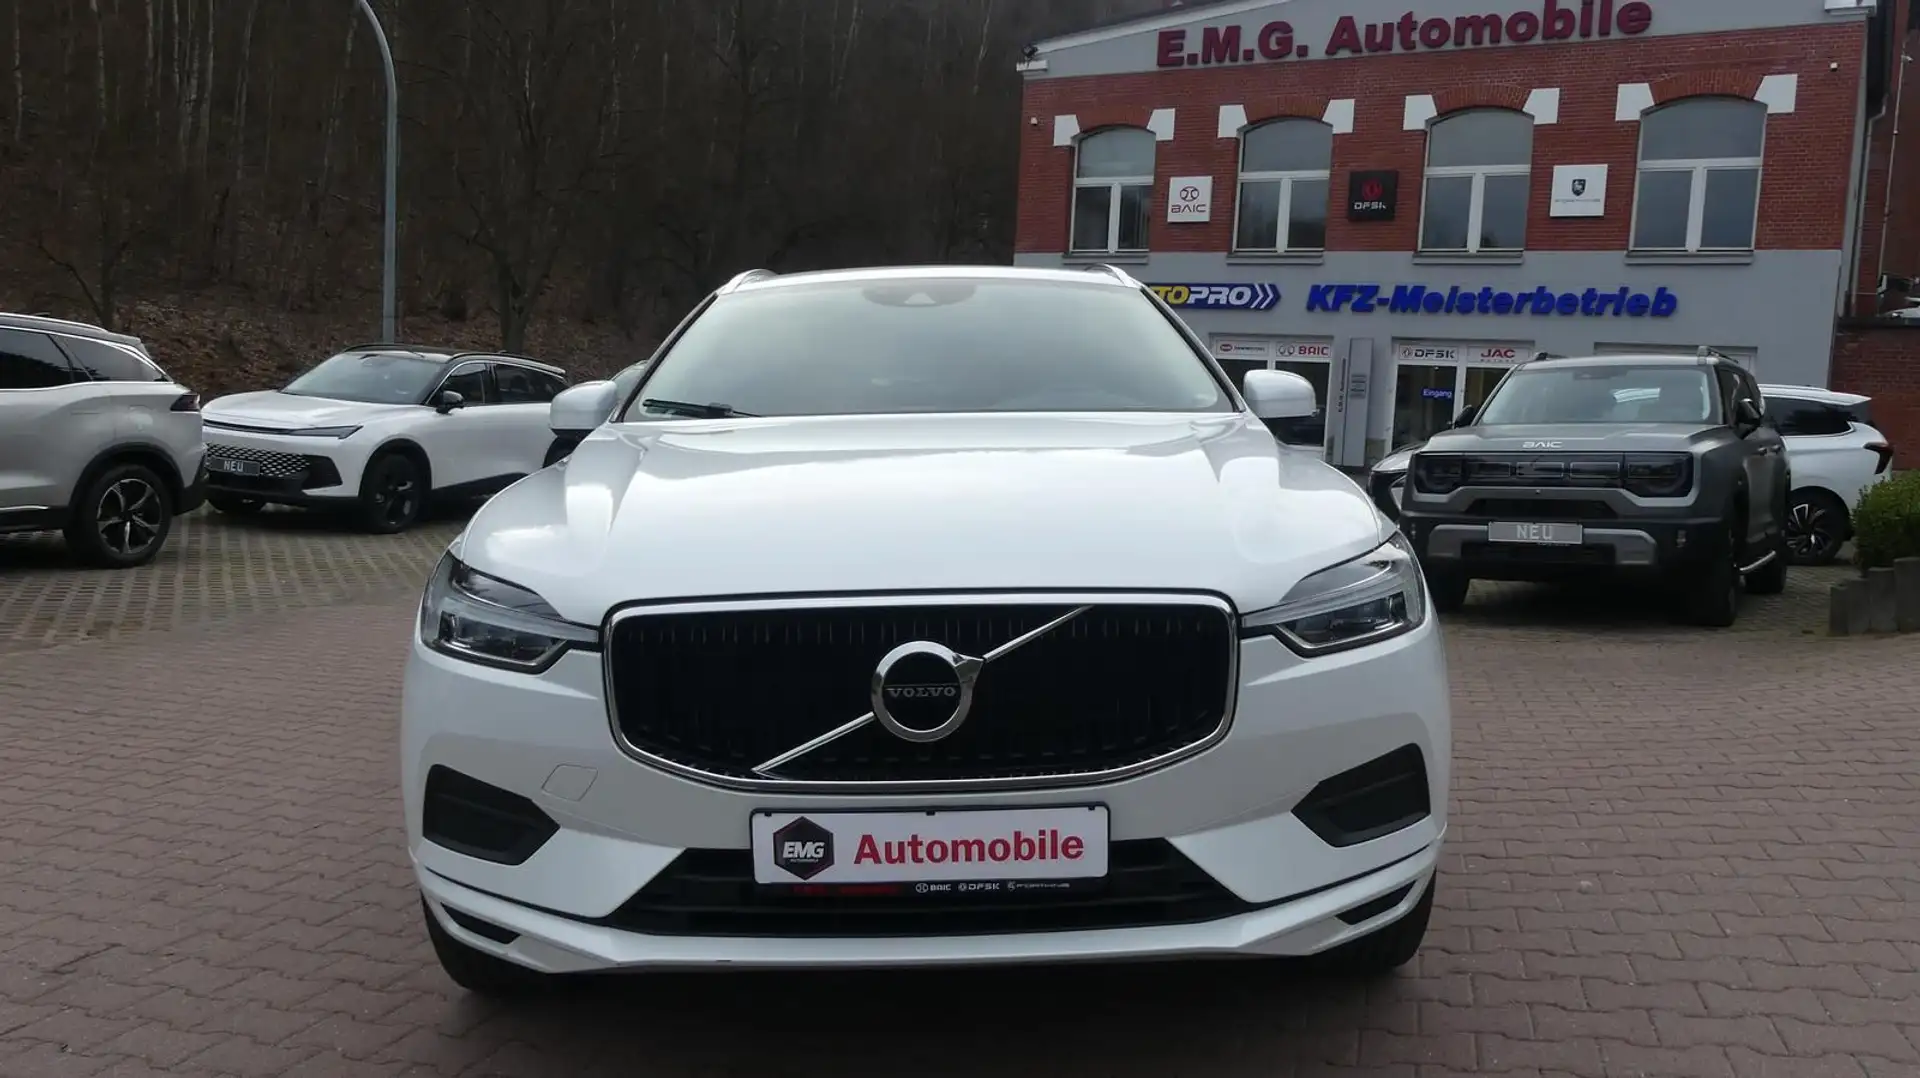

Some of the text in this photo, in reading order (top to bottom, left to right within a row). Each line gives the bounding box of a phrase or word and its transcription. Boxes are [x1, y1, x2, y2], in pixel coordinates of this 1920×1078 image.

[1156, 0, 1653, 67] E.M.G. Automobile
[1171, 203, 1207, 214] BAIC
[1306, 284, 1678, 317] KFZ-Meisterbetrieb
[1298, 345, 1329, 356] BAIC
[1414, 348, 1455, 359] DFSK
[1480, 348, 1516, 359] JAC
[223, 460, 244, 472] NEU
[1516, 524, 1553, 540] NEU
[886, 686, 957, 698] VOLVO
[782, 841, 825, 859] EMG
[853, 829, 1085, 865] Automobile
